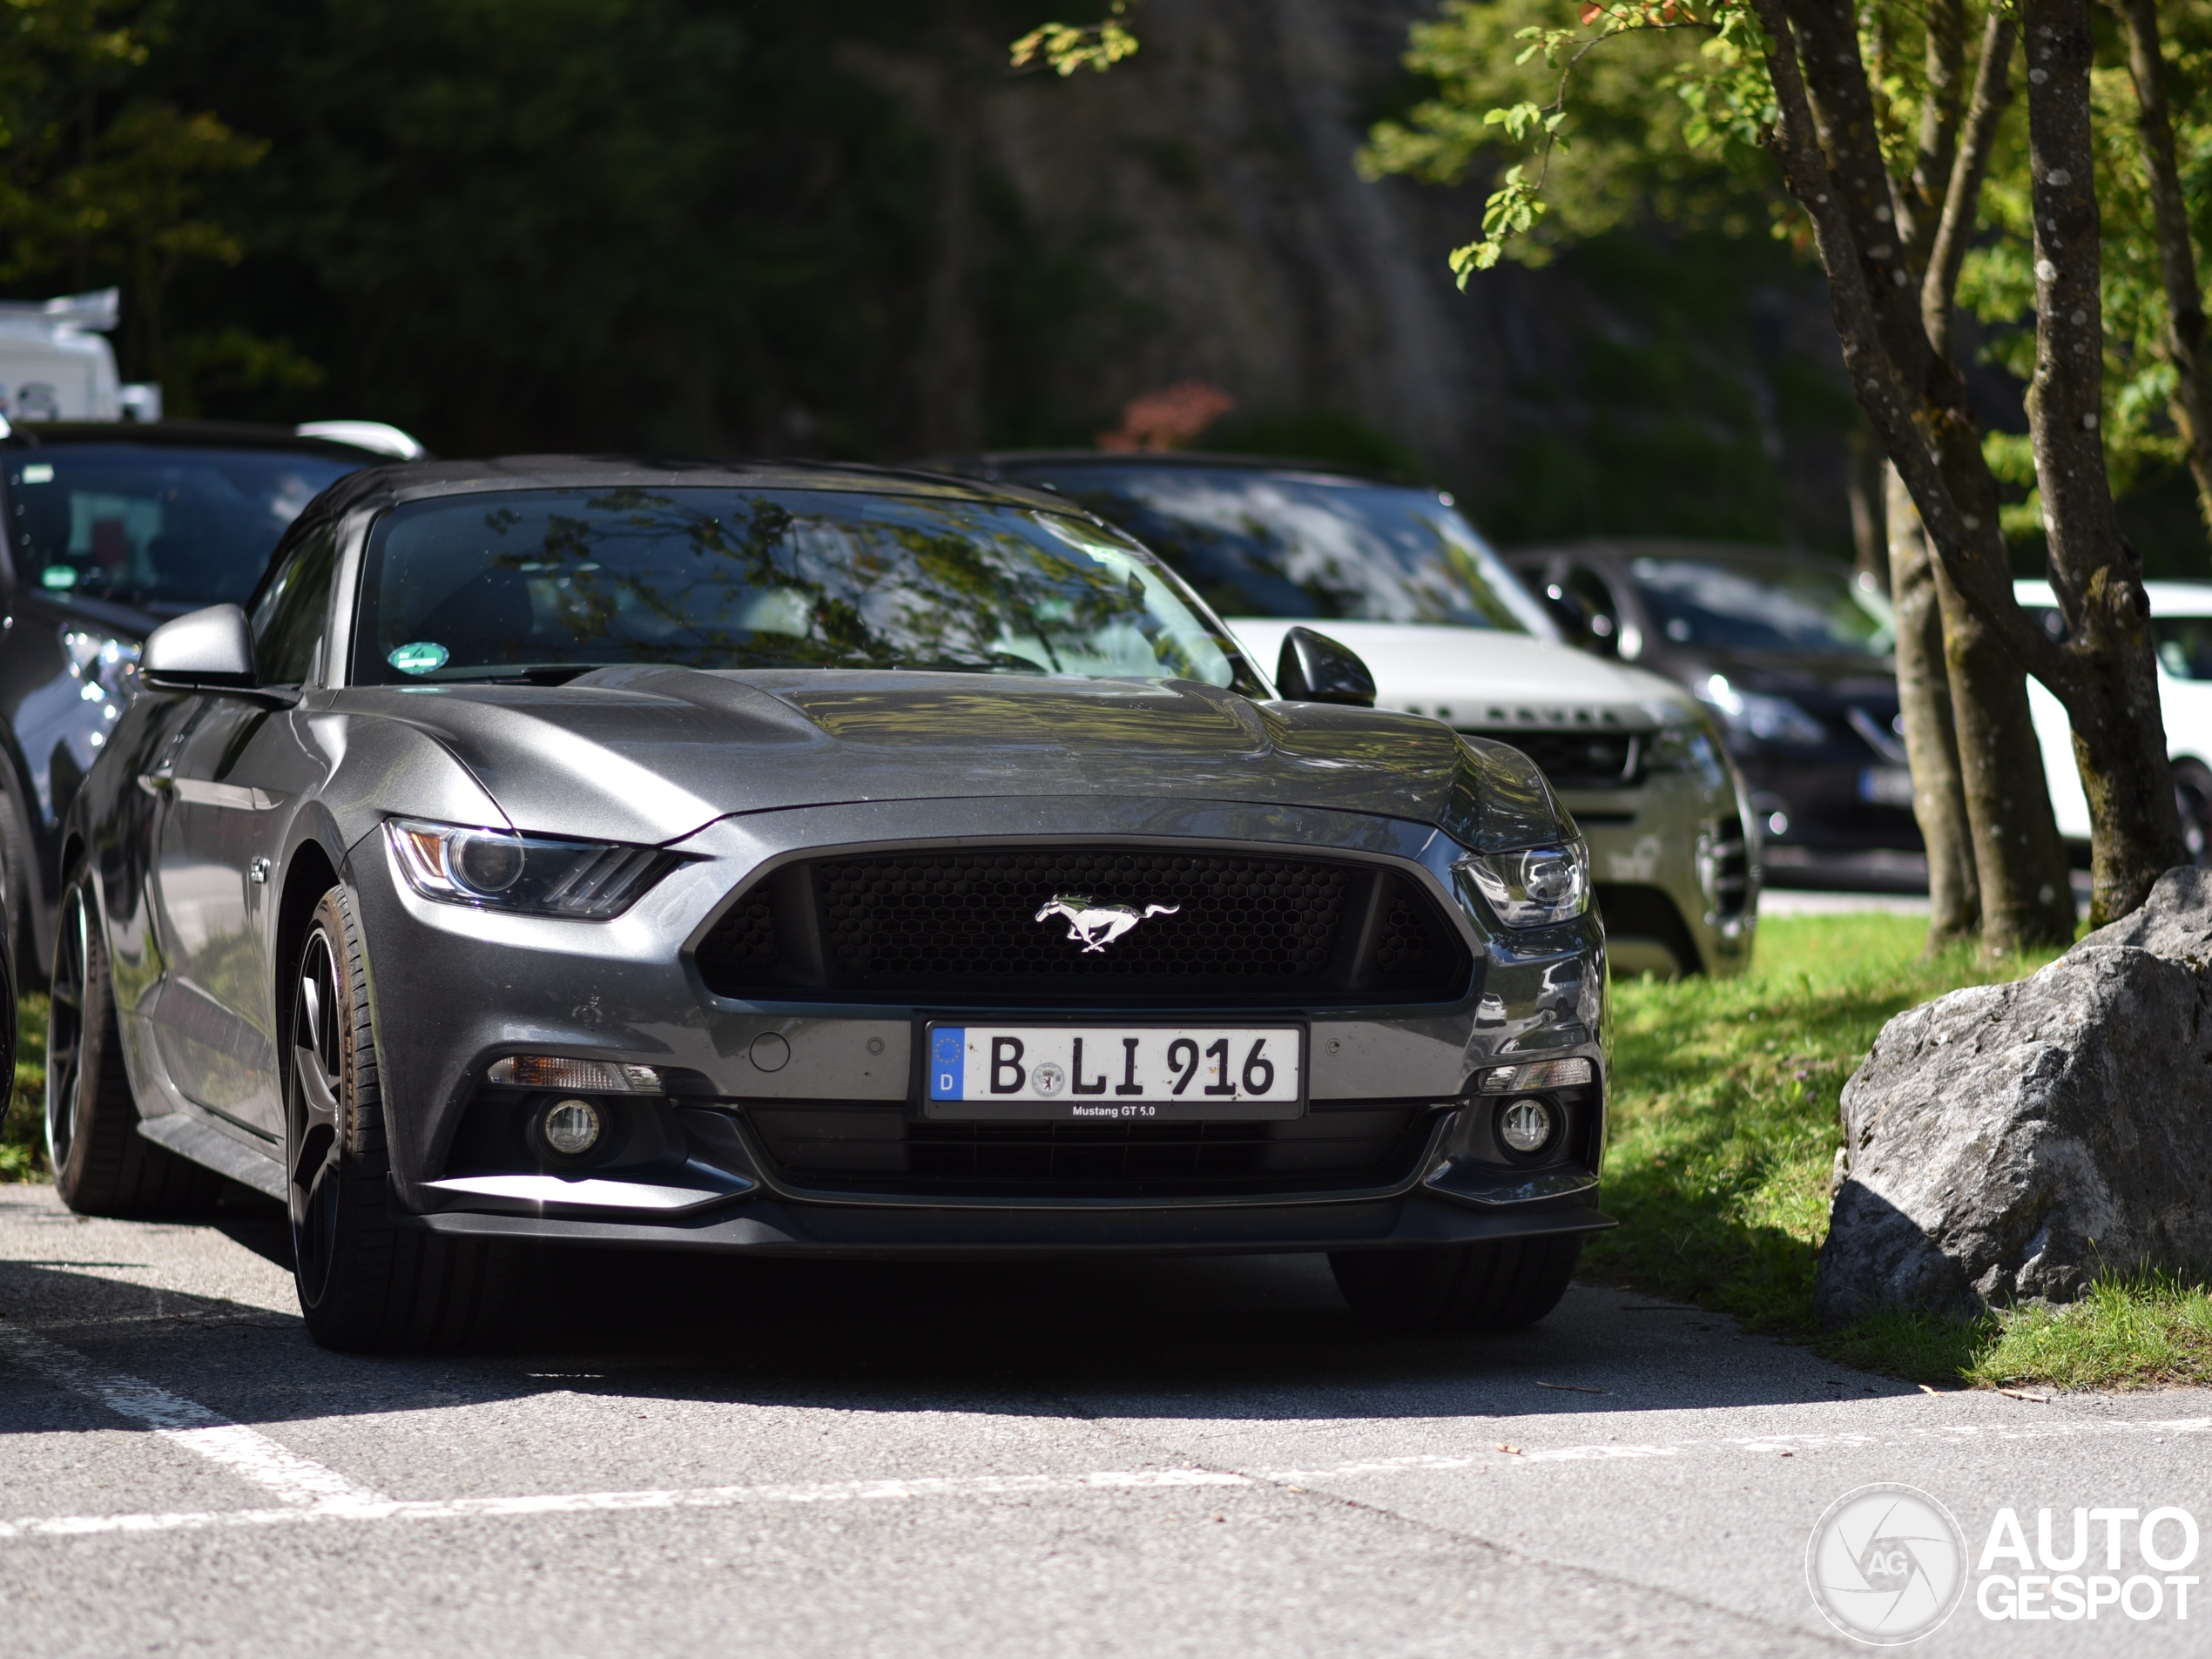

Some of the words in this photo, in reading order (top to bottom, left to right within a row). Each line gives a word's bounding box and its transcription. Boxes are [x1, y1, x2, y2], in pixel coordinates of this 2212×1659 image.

[989, 1036, 1027, 1096] B
[1071, 1037, 1143, 1096] LI
[1165, 1037, 1275, 1096] 916
[940, 1073, 954, 1091] D
[1073, 1105, 1118, 1118] Mustang
[1121, 1105, 1137, 1116] GT
[1140, 1105, 1156, 1116] 5.0
